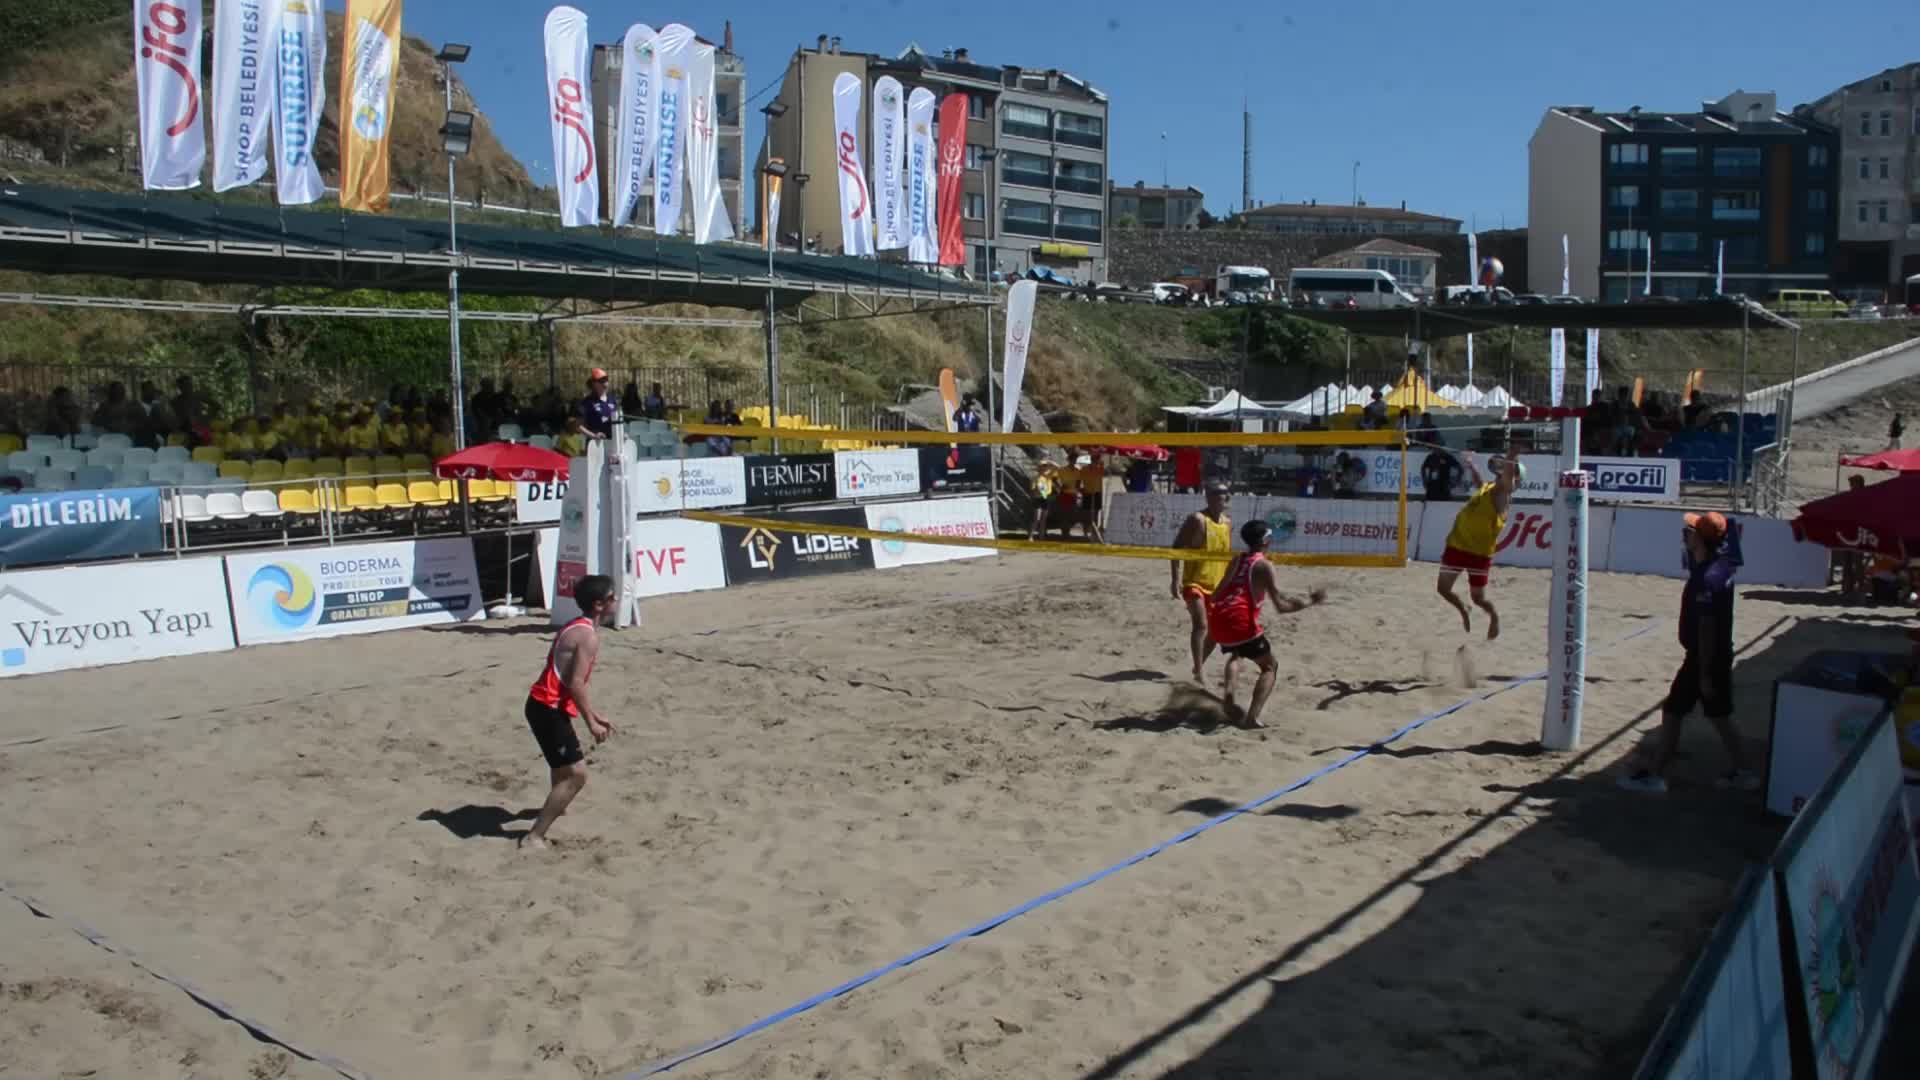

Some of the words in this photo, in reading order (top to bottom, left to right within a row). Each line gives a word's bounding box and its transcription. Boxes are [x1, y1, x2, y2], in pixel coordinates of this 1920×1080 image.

[280, 28, 307, 167] SUNRISE
[660, 90, 677, 205] SUNRISE
[911, 143, 924, 236] SUNRISE
[1601, 468, 1662, 488] profil
[11, 493, 141, 529] DİLERİM.
[792, 534, 860, 555] LİDER
[1341, 522, 1411, 540] BELEDİYEİ
[320, 557, 402, 575] BIODERMA
[636, 546, 685, 579] TVF
[347, 590, 385, 604] SİNOP
[330, 607, 367, 621] GRAND
[12, 620, 134, 649] Vizyon
[139, 608, 214, 637] Yapı
